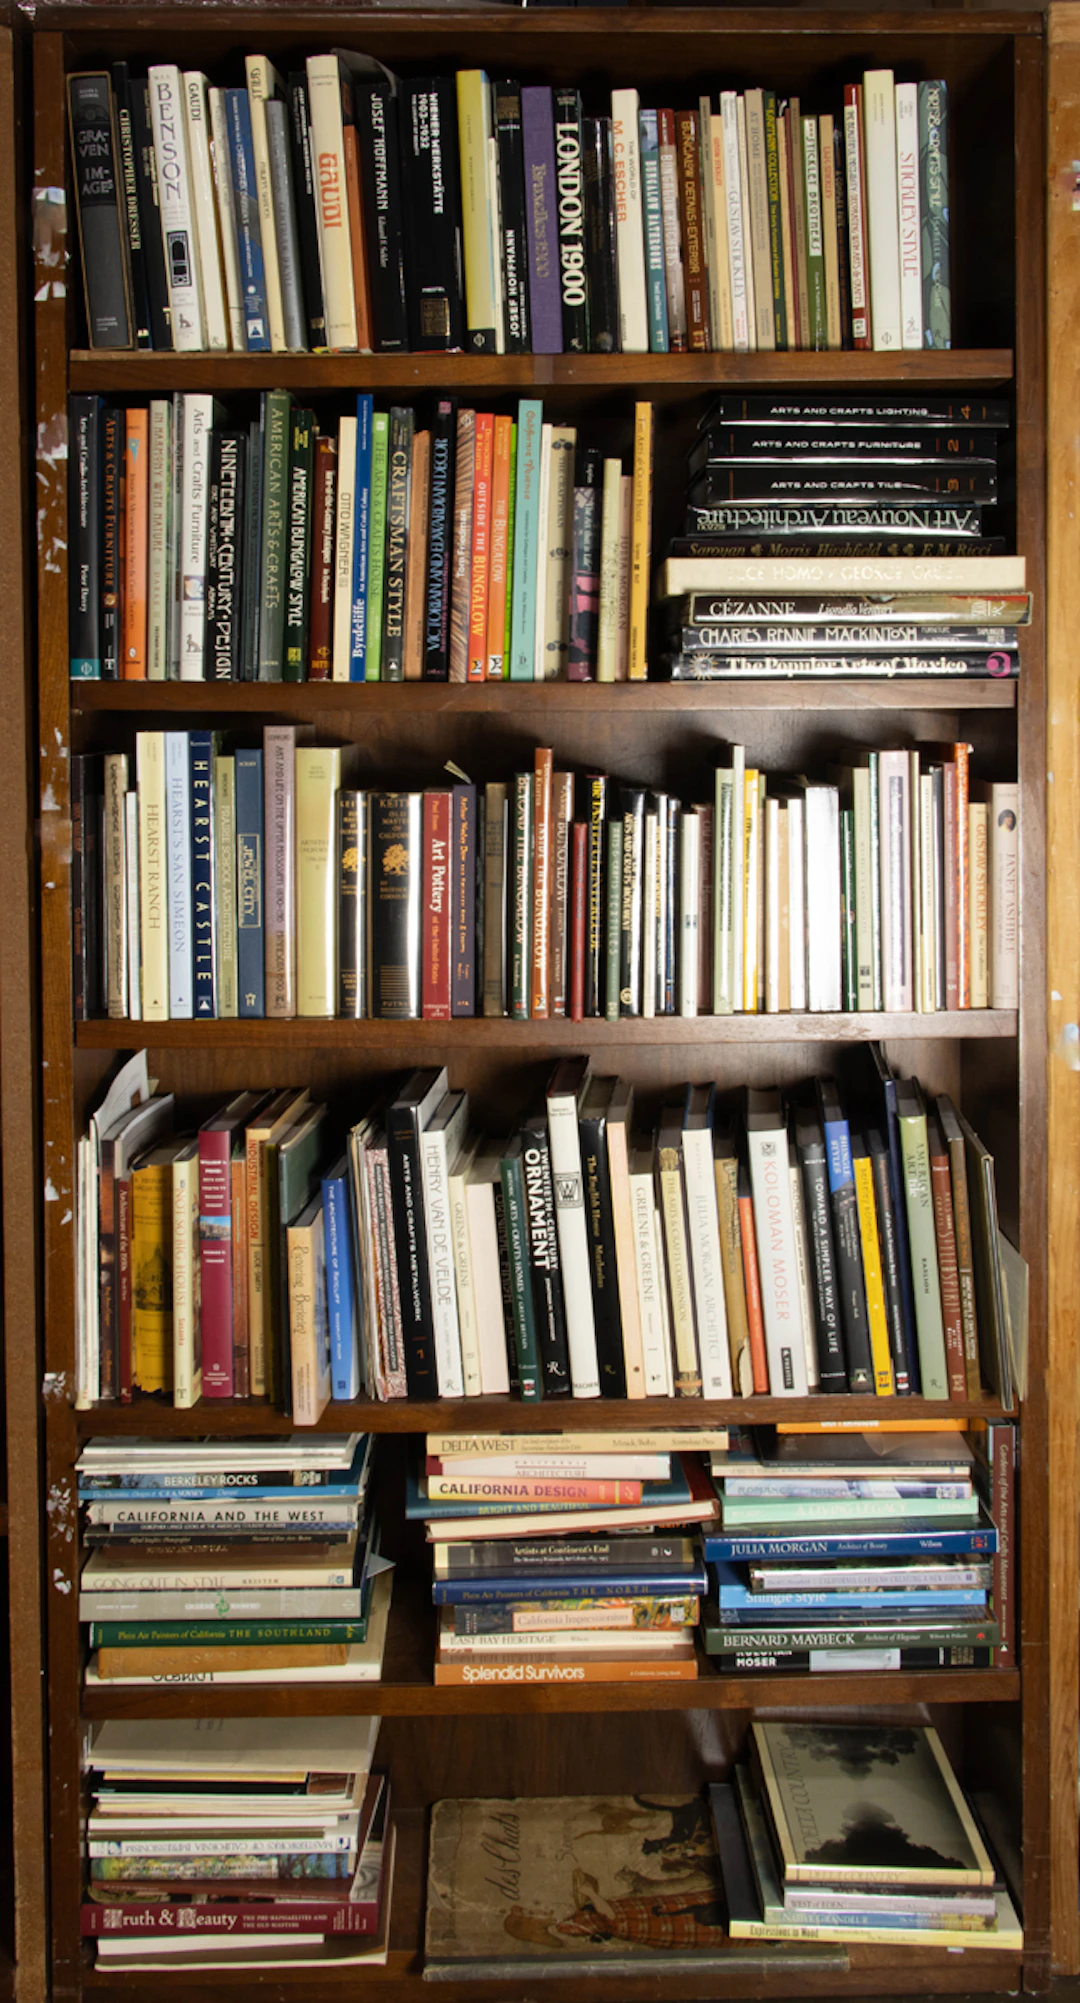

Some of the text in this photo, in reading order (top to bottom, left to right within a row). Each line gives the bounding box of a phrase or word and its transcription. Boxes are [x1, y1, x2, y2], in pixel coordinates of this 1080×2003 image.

[189, 83, 201, 121] GAUDI
[157, 84, 181, 201] BENSON
[370, 93, 388, 210] JOSEF HOFFMANN
[429, 92, 445, 214] WIENER WERKSTÄTTE
[614, 120, 626, 222] M. C. ESCHER
[119, 109, 142, 251] CHRISTOPHER DRESSER
[319, 153, 342, 230] GAUDI
[556, 122, 586, 307] LONDON 1900
[900, 152, 918, 277] STICKLEY STYLE
[505, 230, 519, 338] JOSEF HOFFMANN
[105, 418, 117, 450] ARTS
[192, 408, 205, 434] Arts
[752, 441, 922, 449] ARTS AND CRAFTS FURNITURE
[770, 408, 928, 416] ARTS AND CRAFTS LIGHTING
[104, 464, 117, 510] CRAFTS
[192, 462, 205, 500] Crafts
[265, 408, 284, 608] AMERICAN ARTS & CRAFTS
[104, 515, 116, 586] FURNITURE
[191, 504, 204, 564] Furniture
[288, 466, 306, 626] AMERICAN BUNGALOW STYLE
[338, 492, 350, 576] OTTO WAGNER
[387, 451, 407, 636] CRAFTSMAN STYLE
[456, 510, 468, 578] Tom Friedman
[697, 510, 972, 530] Art Nouveau Architecture
[215, 440, 238, 679] NINETEENTH CENTURY DESIGN
[472, 482, 486, 636] OUTSIDE THE BUNGALOW
[699, 626, 918, 647] CHARLES RENNIE MACKINTOSH
[709, 598, 796, 618] CÉZANNE
[146, 804, 161, 929] HEARST RANCH
[171, 777, 186, 953] HEARST'S SAN SIMEON
[193, 760, 212, 980] HEARST CASTLE
[243, 845, 255, 916] JEWEL CITY
[430, 839, 446, 914] Art Pottery
[976, 824, 987, 932] GUSTAV STICKLEY
[1005, 852, 1017, 955] JANET ASHBEE
[248, 1139, 258, 1240] INDUSTRIAL DESIGN
[906, 1153, 922, 1198] ART tile
[918, 1142, 930, 1208] AMERICAN
[402, 1154, 421, 1322] ARTS AND CRAFTS METALWORK
[427, 1145, 451, 1306] HENRY VAN DE VELDE
[524, 1148, 550, 1270] ORNAMENT
[763, 1160, 789, 1321] KOLOMAN MOSER
[636, 1188, 654, 1303] GREENE & GREENE
[696, 1194, 720, 1362] JULIA MORGAN ARCHITECT
[815, 1176, 838, 1354] TOWARD A SIMPLER WAY OF LIFE
[442, 1440, 517, 1452] DELTA WEST
[999, 1444, 1010, 1477] Gardens
[164, 1475, 258, 1487] BERKELEY ROCKS
[440, 1484, 587, 1498] CALIFORNIA DESIGN
[478, 1503, 590, 1516] BRIGHT AND BEAUTIFUL
[999, 1478, 1010, 1486] of
[1000, 1488, 1010, 1498] the
[1000, 1501, 1009, 1516] Arts
[117, 1511, 325, 1522] CALIFORNIA AND THE WEST
[730, 1541, 828, 1557] JULIA MORGAN
[1000, 1518, 1009, 1533] and
[1000, 1559, 1009, 1600] Movement
[118, 1628, 332, 1640] Plein Air Painters of California THE SOUTHLAND
[450, 1635, 556, 1645] EAST BAY HERITAGE
[517, 1612, 629, 1626] California Impressionism
[723, 1634, 856, 1647] BERNARD MAYBECK
[462, 1665, 585, 1682] Splendid Survivors
[736, 1657, 777, 1667] MOSER
[158, 1910, 174, 1928] &
[801, 1926, 820, 1939] Wood
